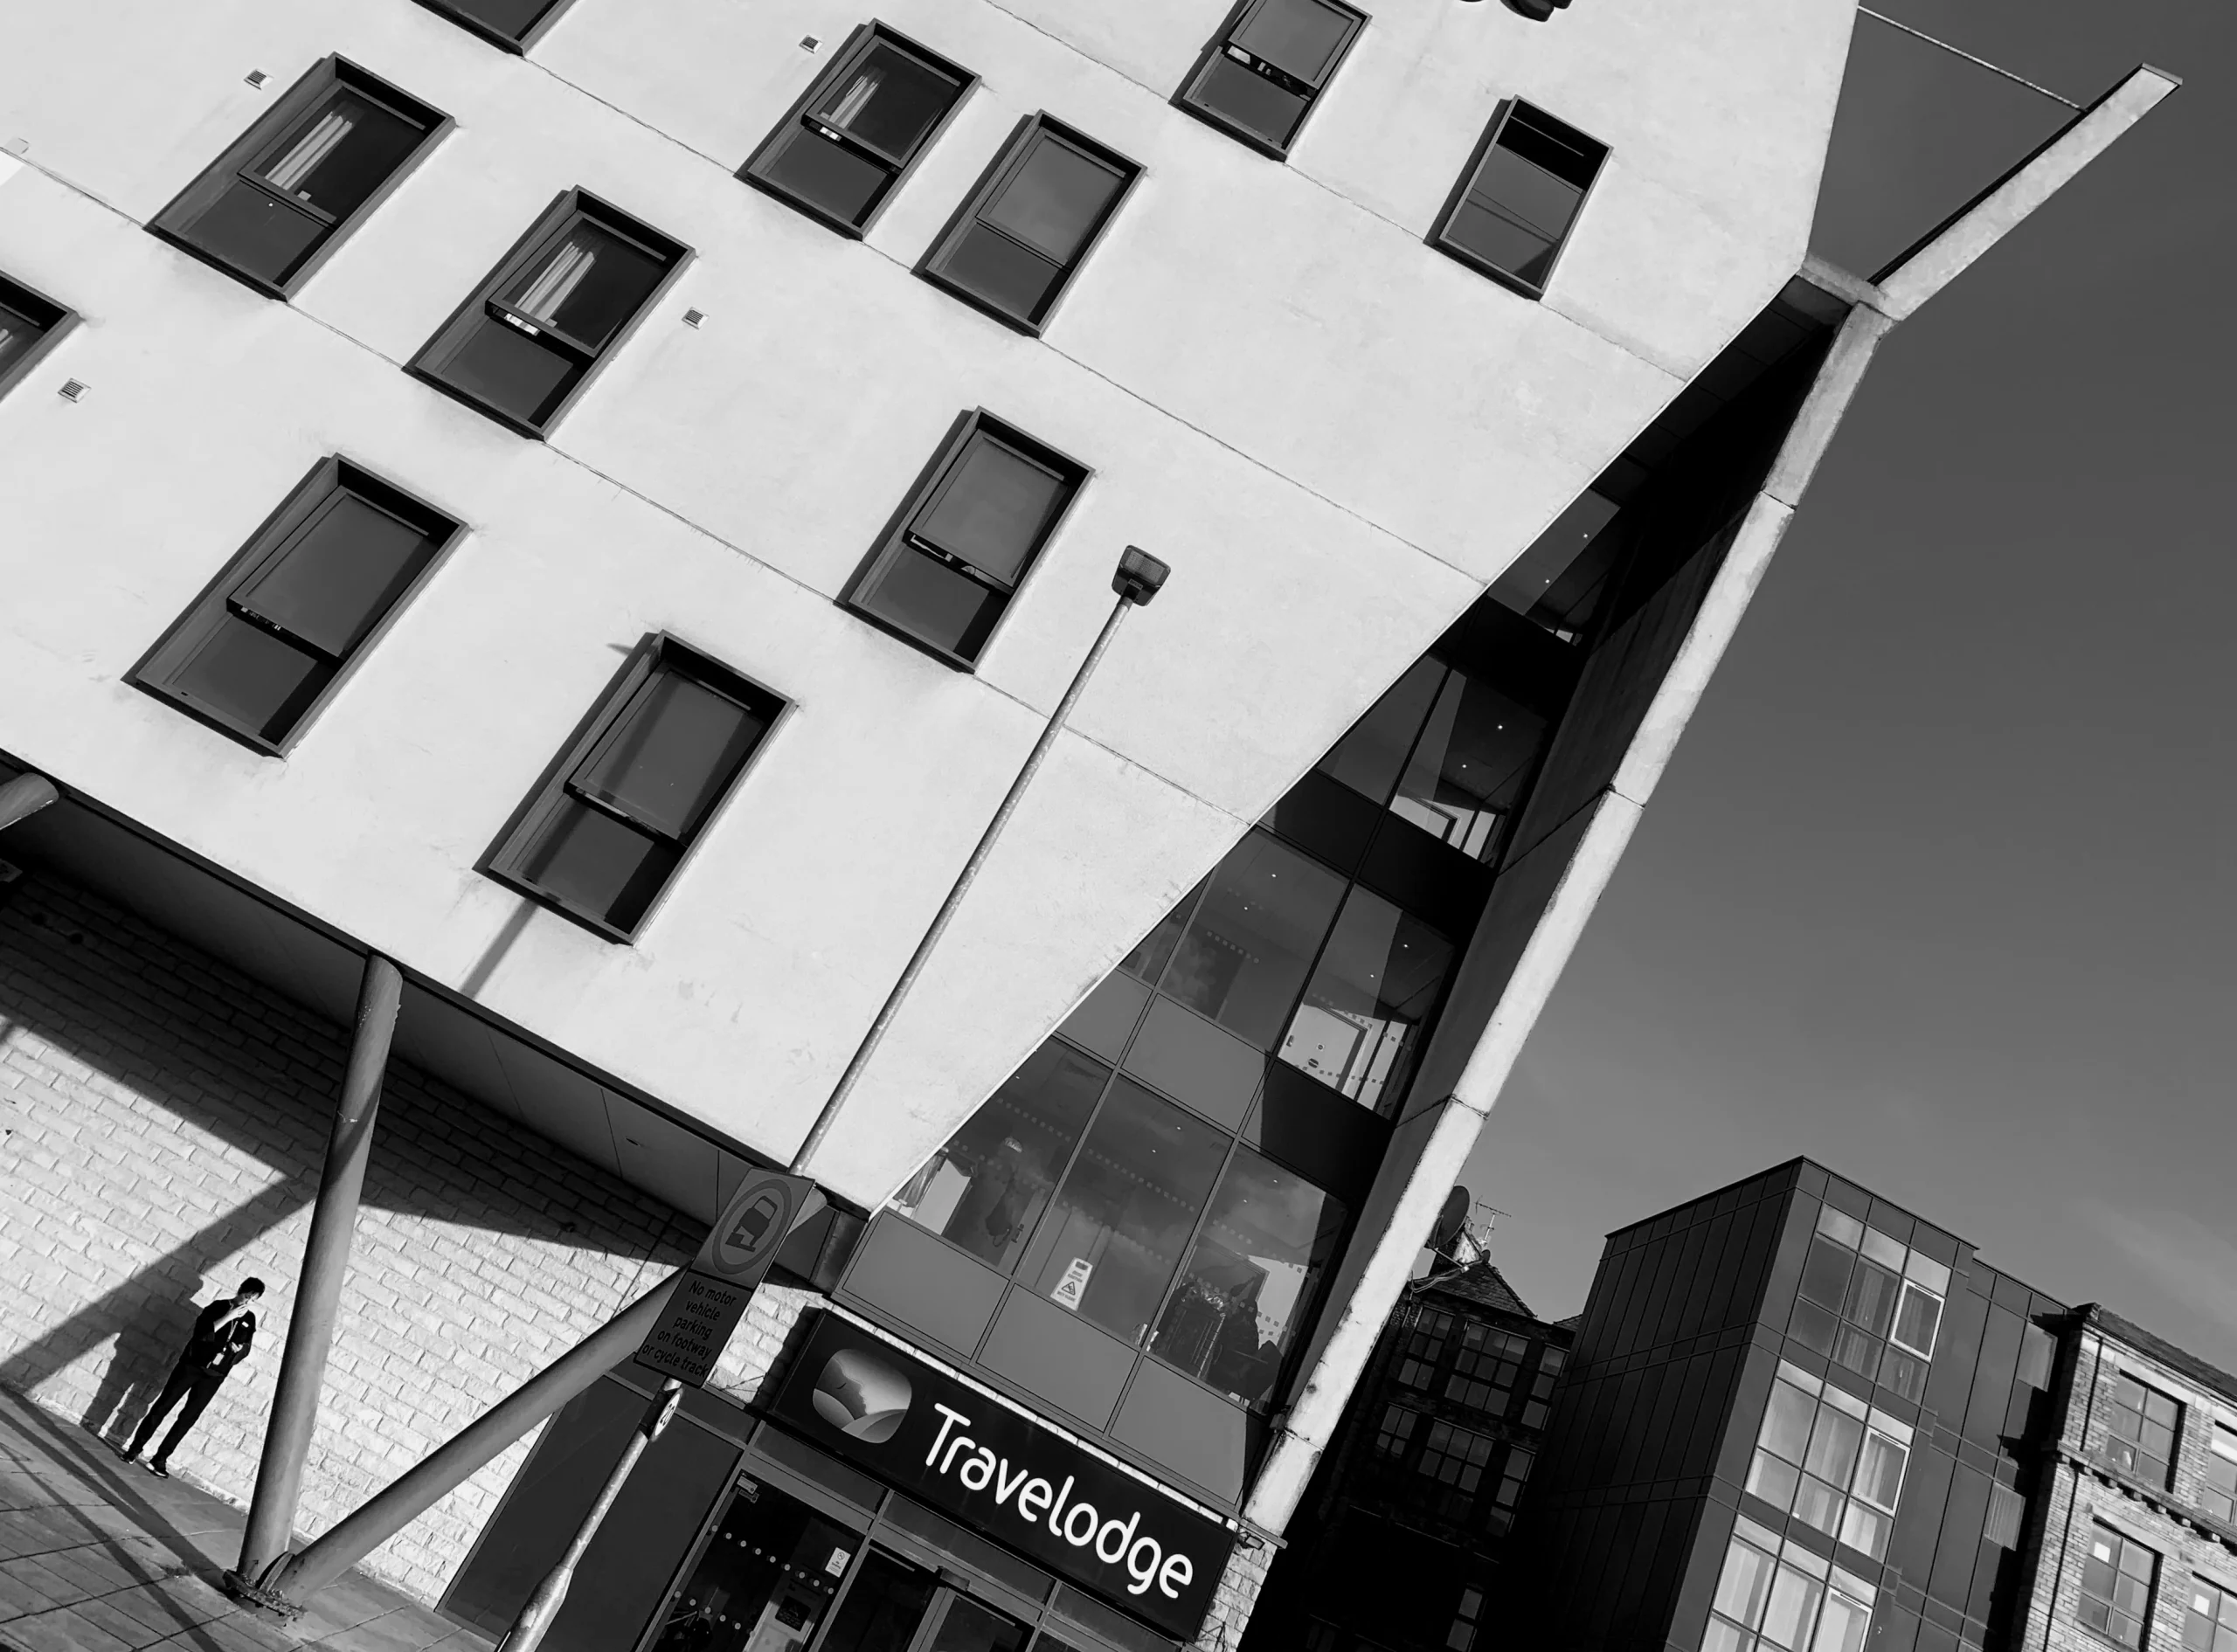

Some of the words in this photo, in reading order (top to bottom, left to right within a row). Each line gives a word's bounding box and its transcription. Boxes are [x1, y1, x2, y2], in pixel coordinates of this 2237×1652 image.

[689, 1280, 704, 1296] No
[704, 1289, 738, 1307] motor
[685, 1300, 721, 1321] vehicle
[672, 1317, 713, 1341] parking
[657, 1330, 671, 1343] on
[670, 1332, 712, 1361] footway
[641, 1344, 655, 1356] or
[654, 1350, 681, 1367] cycle
[680, 1357, 709, 1377] track
[660, 1403, 675, 1426] 20
[926, 1402, 1193, 1599] Travelodge
